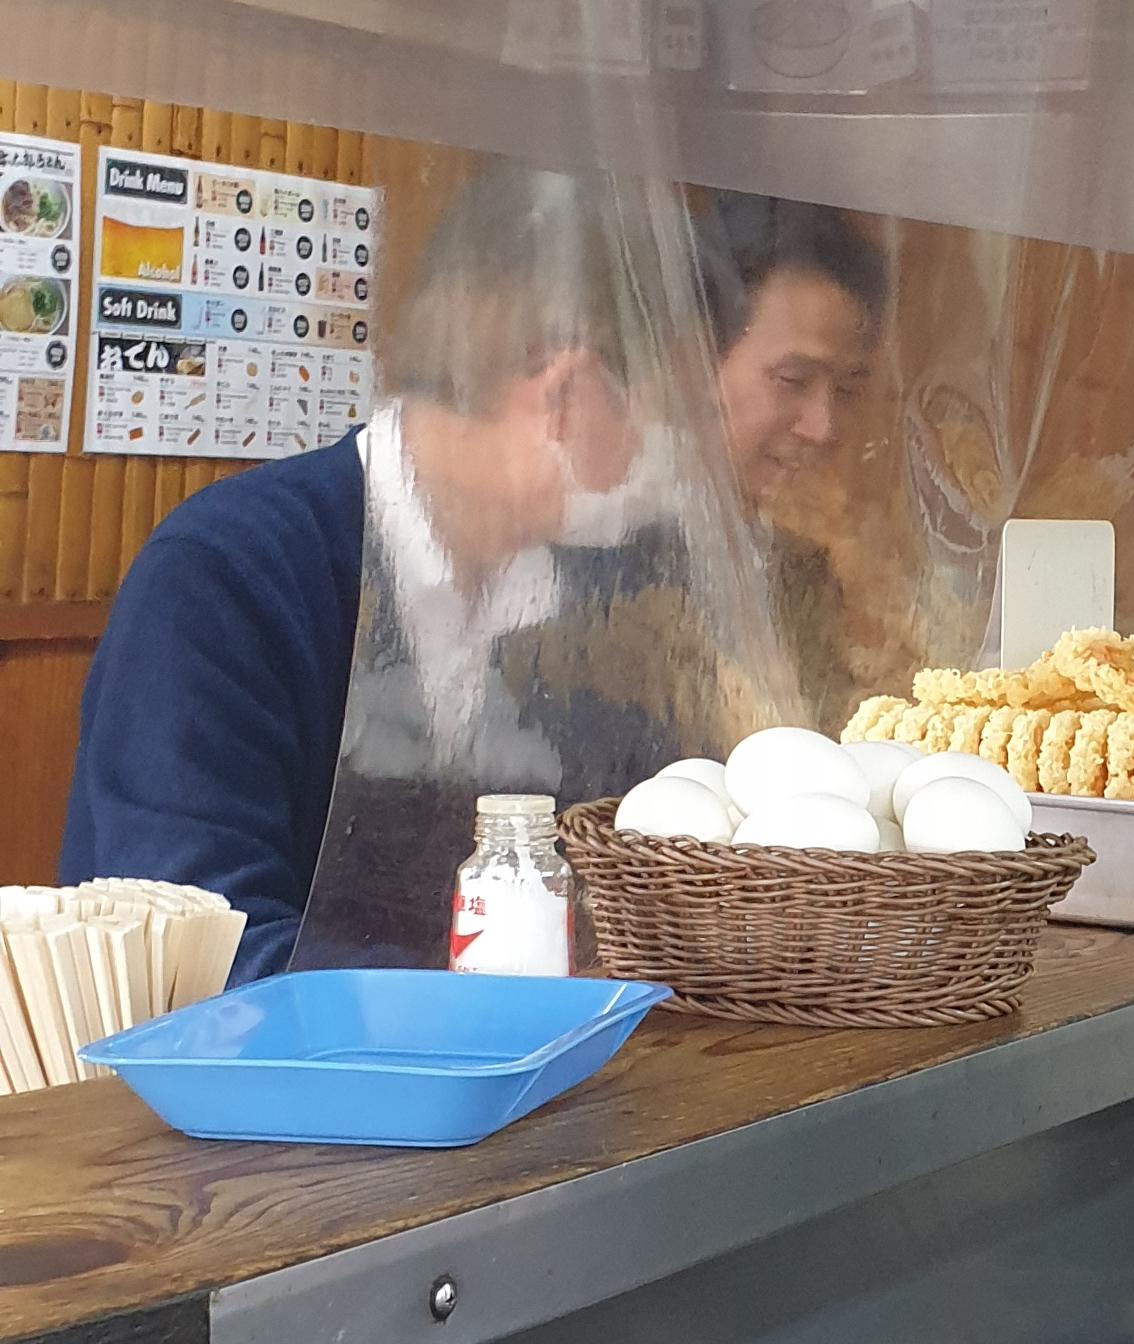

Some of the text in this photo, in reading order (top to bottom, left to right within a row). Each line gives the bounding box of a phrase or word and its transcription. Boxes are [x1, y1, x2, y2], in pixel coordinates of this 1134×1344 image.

[109, 167, 144, 190] Drink
[146, 172, 184, 196] Menu
[103, 296, 176, 321] Soft Drink
